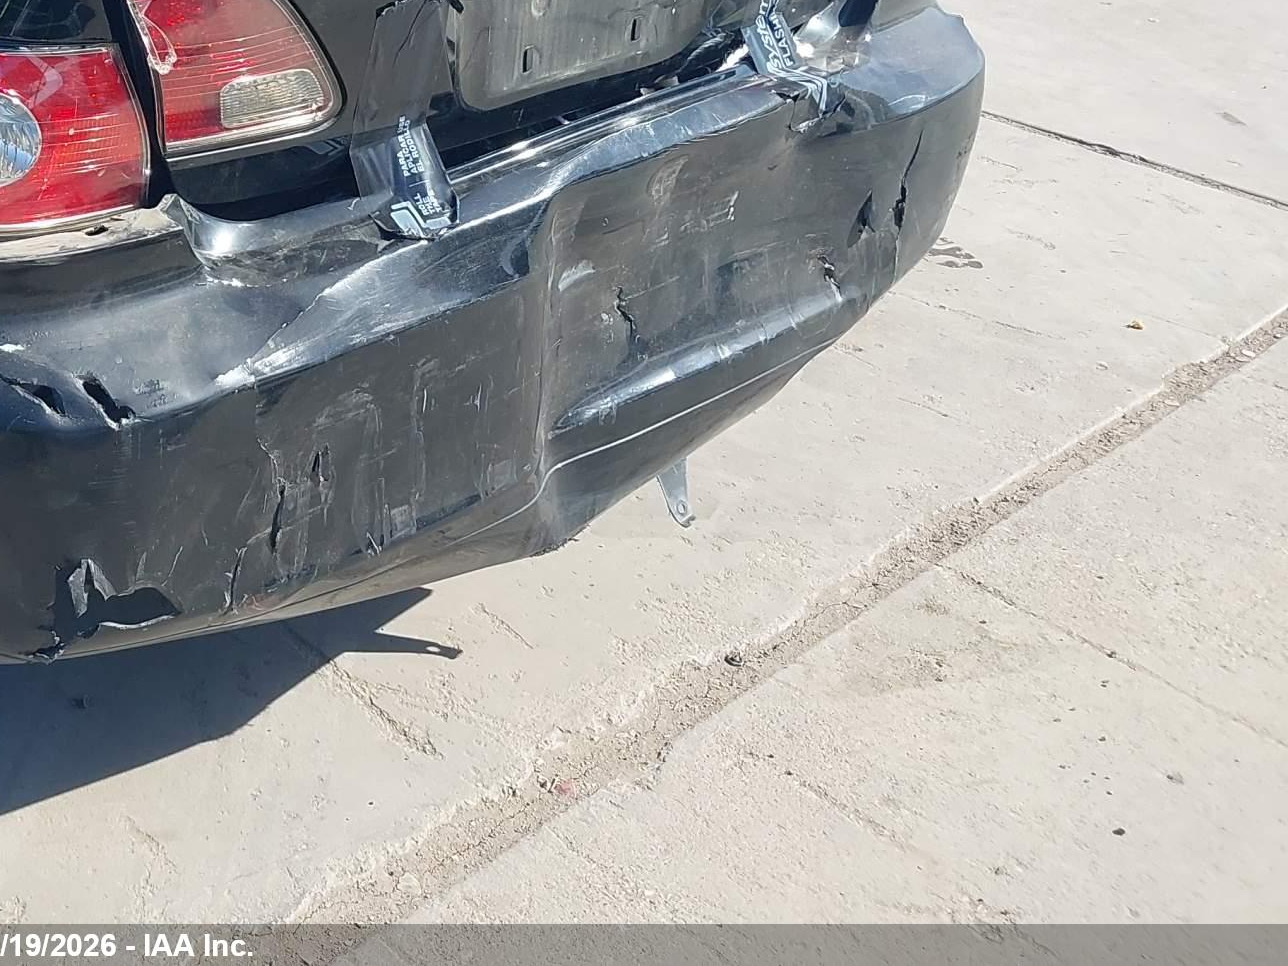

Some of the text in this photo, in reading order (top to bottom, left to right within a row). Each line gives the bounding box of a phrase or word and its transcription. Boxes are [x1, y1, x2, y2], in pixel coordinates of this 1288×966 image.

[397, 134, 418, 174] APLICAR
[397, 150, 411, 177] PARA
[414, 192, 430, 216] ROLL
